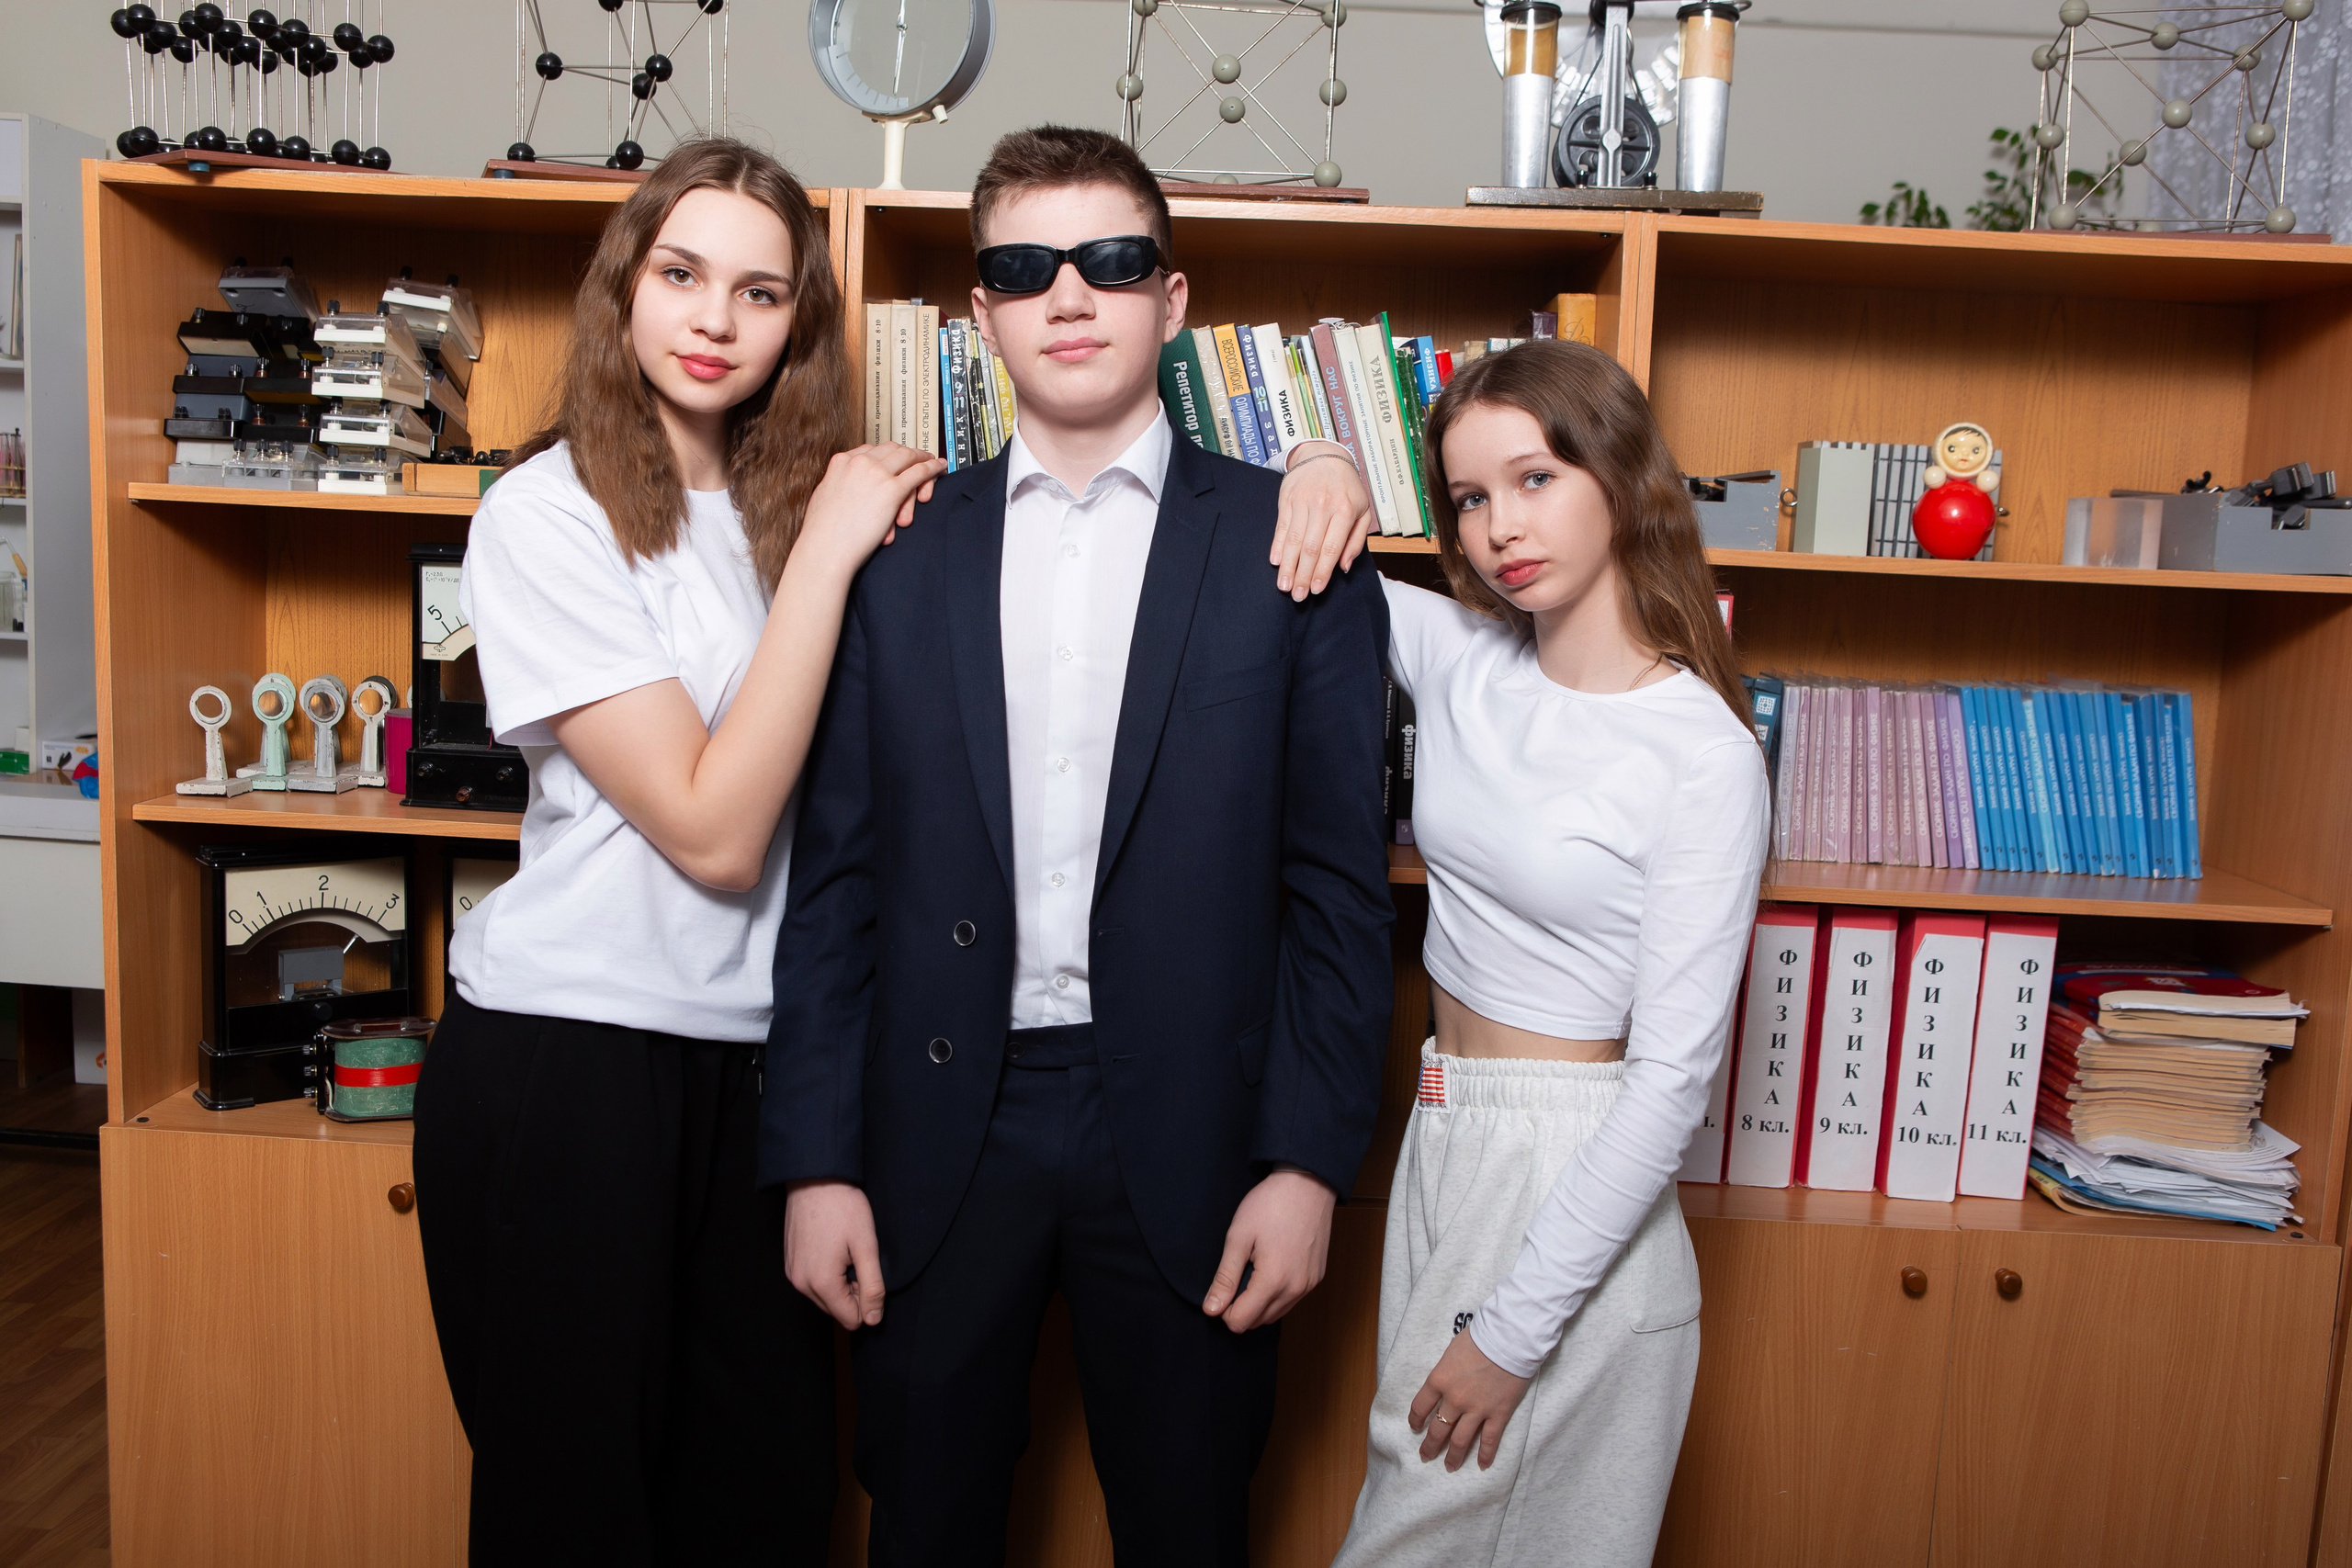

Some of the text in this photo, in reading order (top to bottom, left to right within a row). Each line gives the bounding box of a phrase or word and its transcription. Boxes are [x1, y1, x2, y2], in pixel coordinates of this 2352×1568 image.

[874, 339, 882, 366] физики
[922, 313, 931, 386] ЭЛЕКТРОДИНАМИКЕ
[949, 328, 964, 374] Физика
[1241, 333, 1261, 378] Физика
[1423, 347, 1437, 390] ФИЗИКА
[922, 389, 930, 399] ПО
[1173, 361, 1199, 431] Репетитор
[1221, 338, 1245, 392] ВСЕРОССИЙСКИЕ
[1234, 396, 1257, 446] ОЛИМПИАДЫ
[1246, 445, 1260, 457] ПО
[1254, 387, 1267, 399] 10
[1310, 369, 1322, 395] тетрадь
[1325, 366, 1351, 437] ВОКРУГ НАС
[1368, 355, 1394, 423] ФИЗИКА
[1001, 396, 1010, 412] ПО
[1258, 400, 1270, 412] 11
[1277, 389, 1296, 437] ФИЗИКА
[1348, 360, 1387, 503] ФРОНТАЛЬНЫЕ ЛАБОРАТОРНЫЕ ЗАНЯТИЯ ПО ФИЗИКЕ
[427, 604, 443, 621] 5
[1402, 724, 1416, 780] физика
[1843, 750, 1849, 762] ПО
[1871, 749, 1878, 761] ПО
[2030, 739, 2039, 751] ПО
[2129, 744, 2137, 756] ПО
[2165, 744, 2174, 757] ПО
[1796, 764, 1804, 790] ЗАДАЧ
[1912, 716, 1926, 836] СБОРНИК ЗАДАЧ ПО ФИЗИКЕ
[1928, 719, 1943, 838] СБОРНИК ЗАДАЧ ПО ФИЗИКЕ
[1939, 716, 1958, 839] СБОРНИК ЗАДАЧ ПО ФИЗИКЕ
[1952, 728, 1973, 850] СБОРНИК ЗАДАЧ ПО ФИЗИКЕ
[1794, 794, 1804, 830] СБОРНИК
[1903, 798, 1911, 835] СБОРНИК
[229, 874, 401, 925] 0 1 2 3
[459, 896, 473, 910] 0
[1764, 948, 1798, 1106] ФИЗИКА
[1842, 951, 1873, 1108] ФИЗИКА
[1912, 957, 1945, 1117] ФИЗИКА
[2001, 958, 2040, 1116] ФИЗИКА
[1741, 1114, 1790, 1134] 8 кл.
[1819, 1116, 1868, 1136] 9 кл.
[1897, 1126, 1958, 1146] 10 кл.
[1967, 1123, 2027, 1145] 11 кл.
